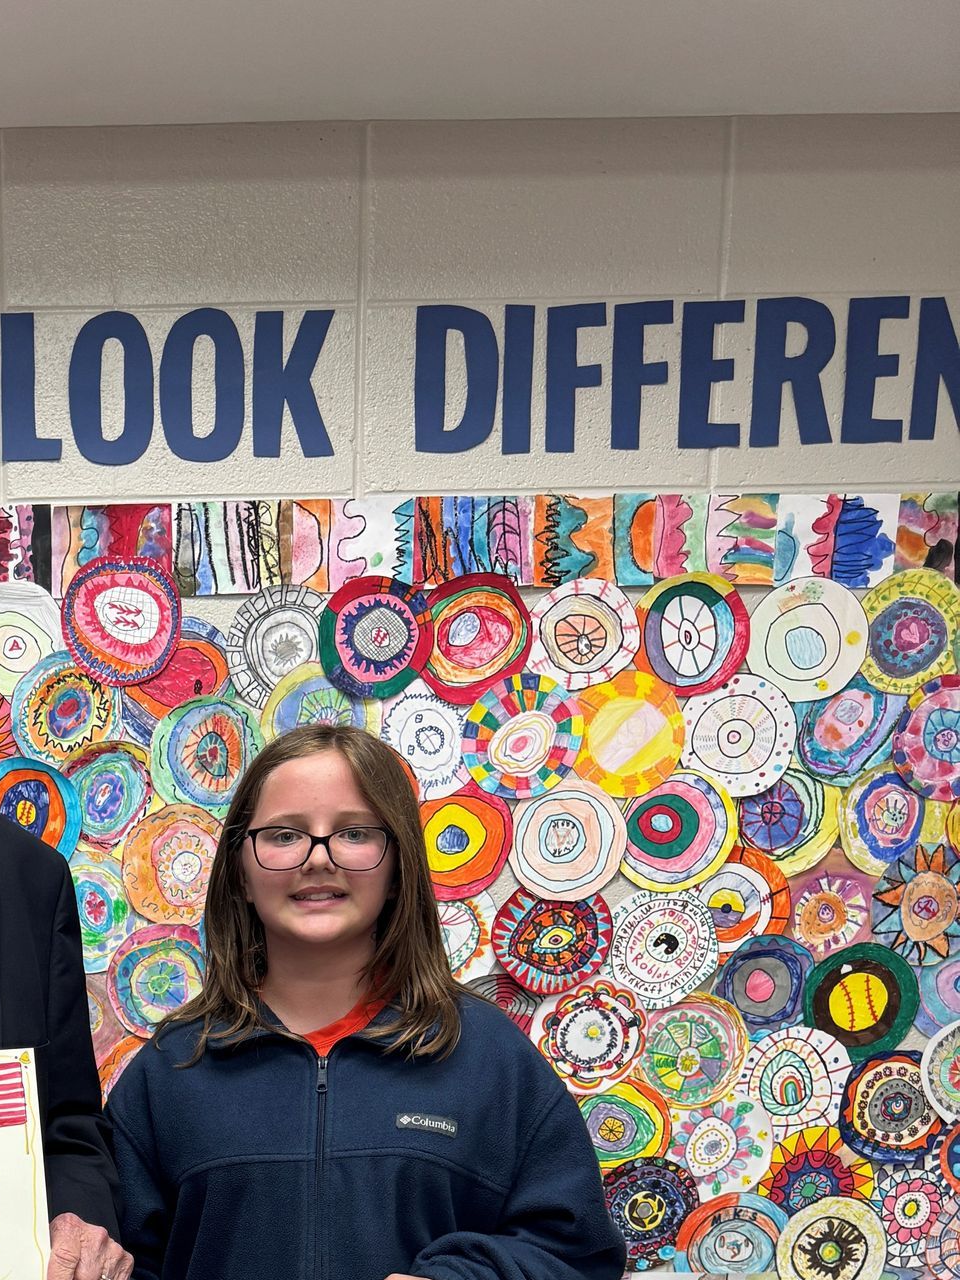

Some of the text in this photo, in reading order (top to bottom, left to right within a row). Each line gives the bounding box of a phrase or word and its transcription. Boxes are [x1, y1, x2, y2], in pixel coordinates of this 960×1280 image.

[1, 308, 335, 465] LOOK
[415, 296, 960, 454] DIFFEREN
[412, 1116, 456, 1133] Columbia
